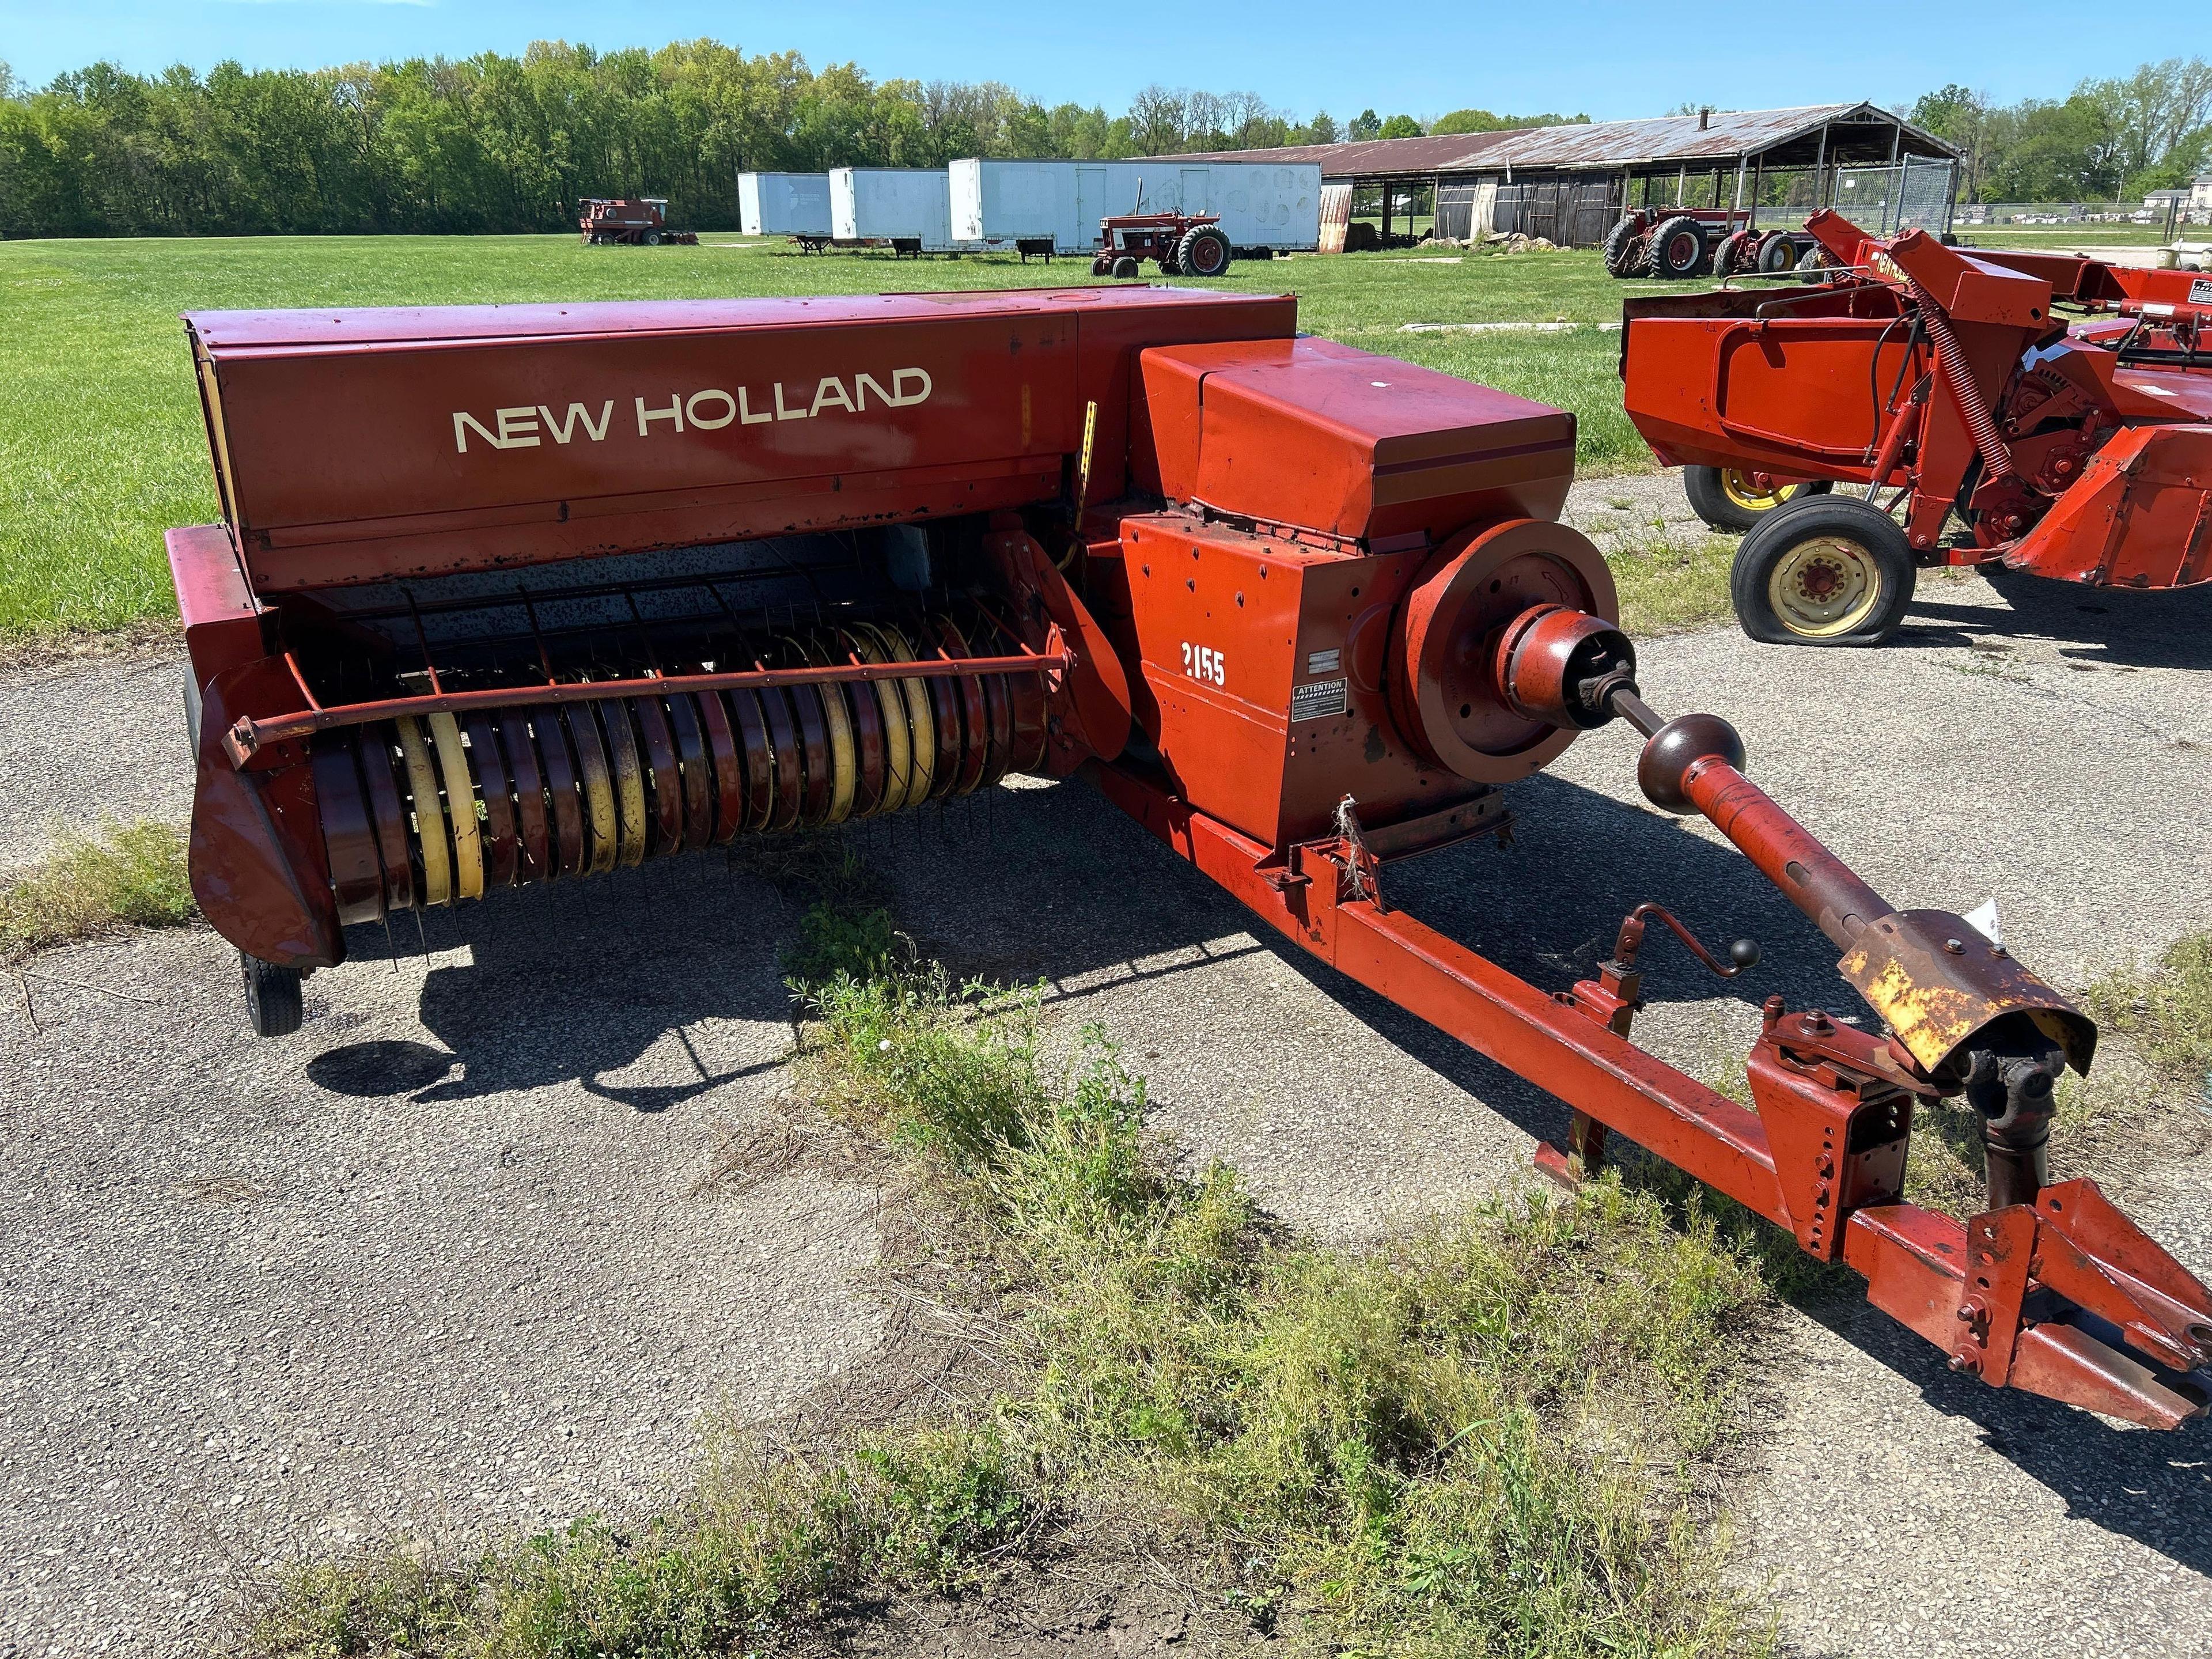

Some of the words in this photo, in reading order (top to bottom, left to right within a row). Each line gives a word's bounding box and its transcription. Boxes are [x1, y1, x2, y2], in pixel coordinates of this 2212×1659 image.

[453, 400, 614, 453] NEW
[635, 368, 933, 437] HOLLAND
[1181, 642, 1225, 686] 2155
[1298, 681, 1342, 695] ATTENTION
